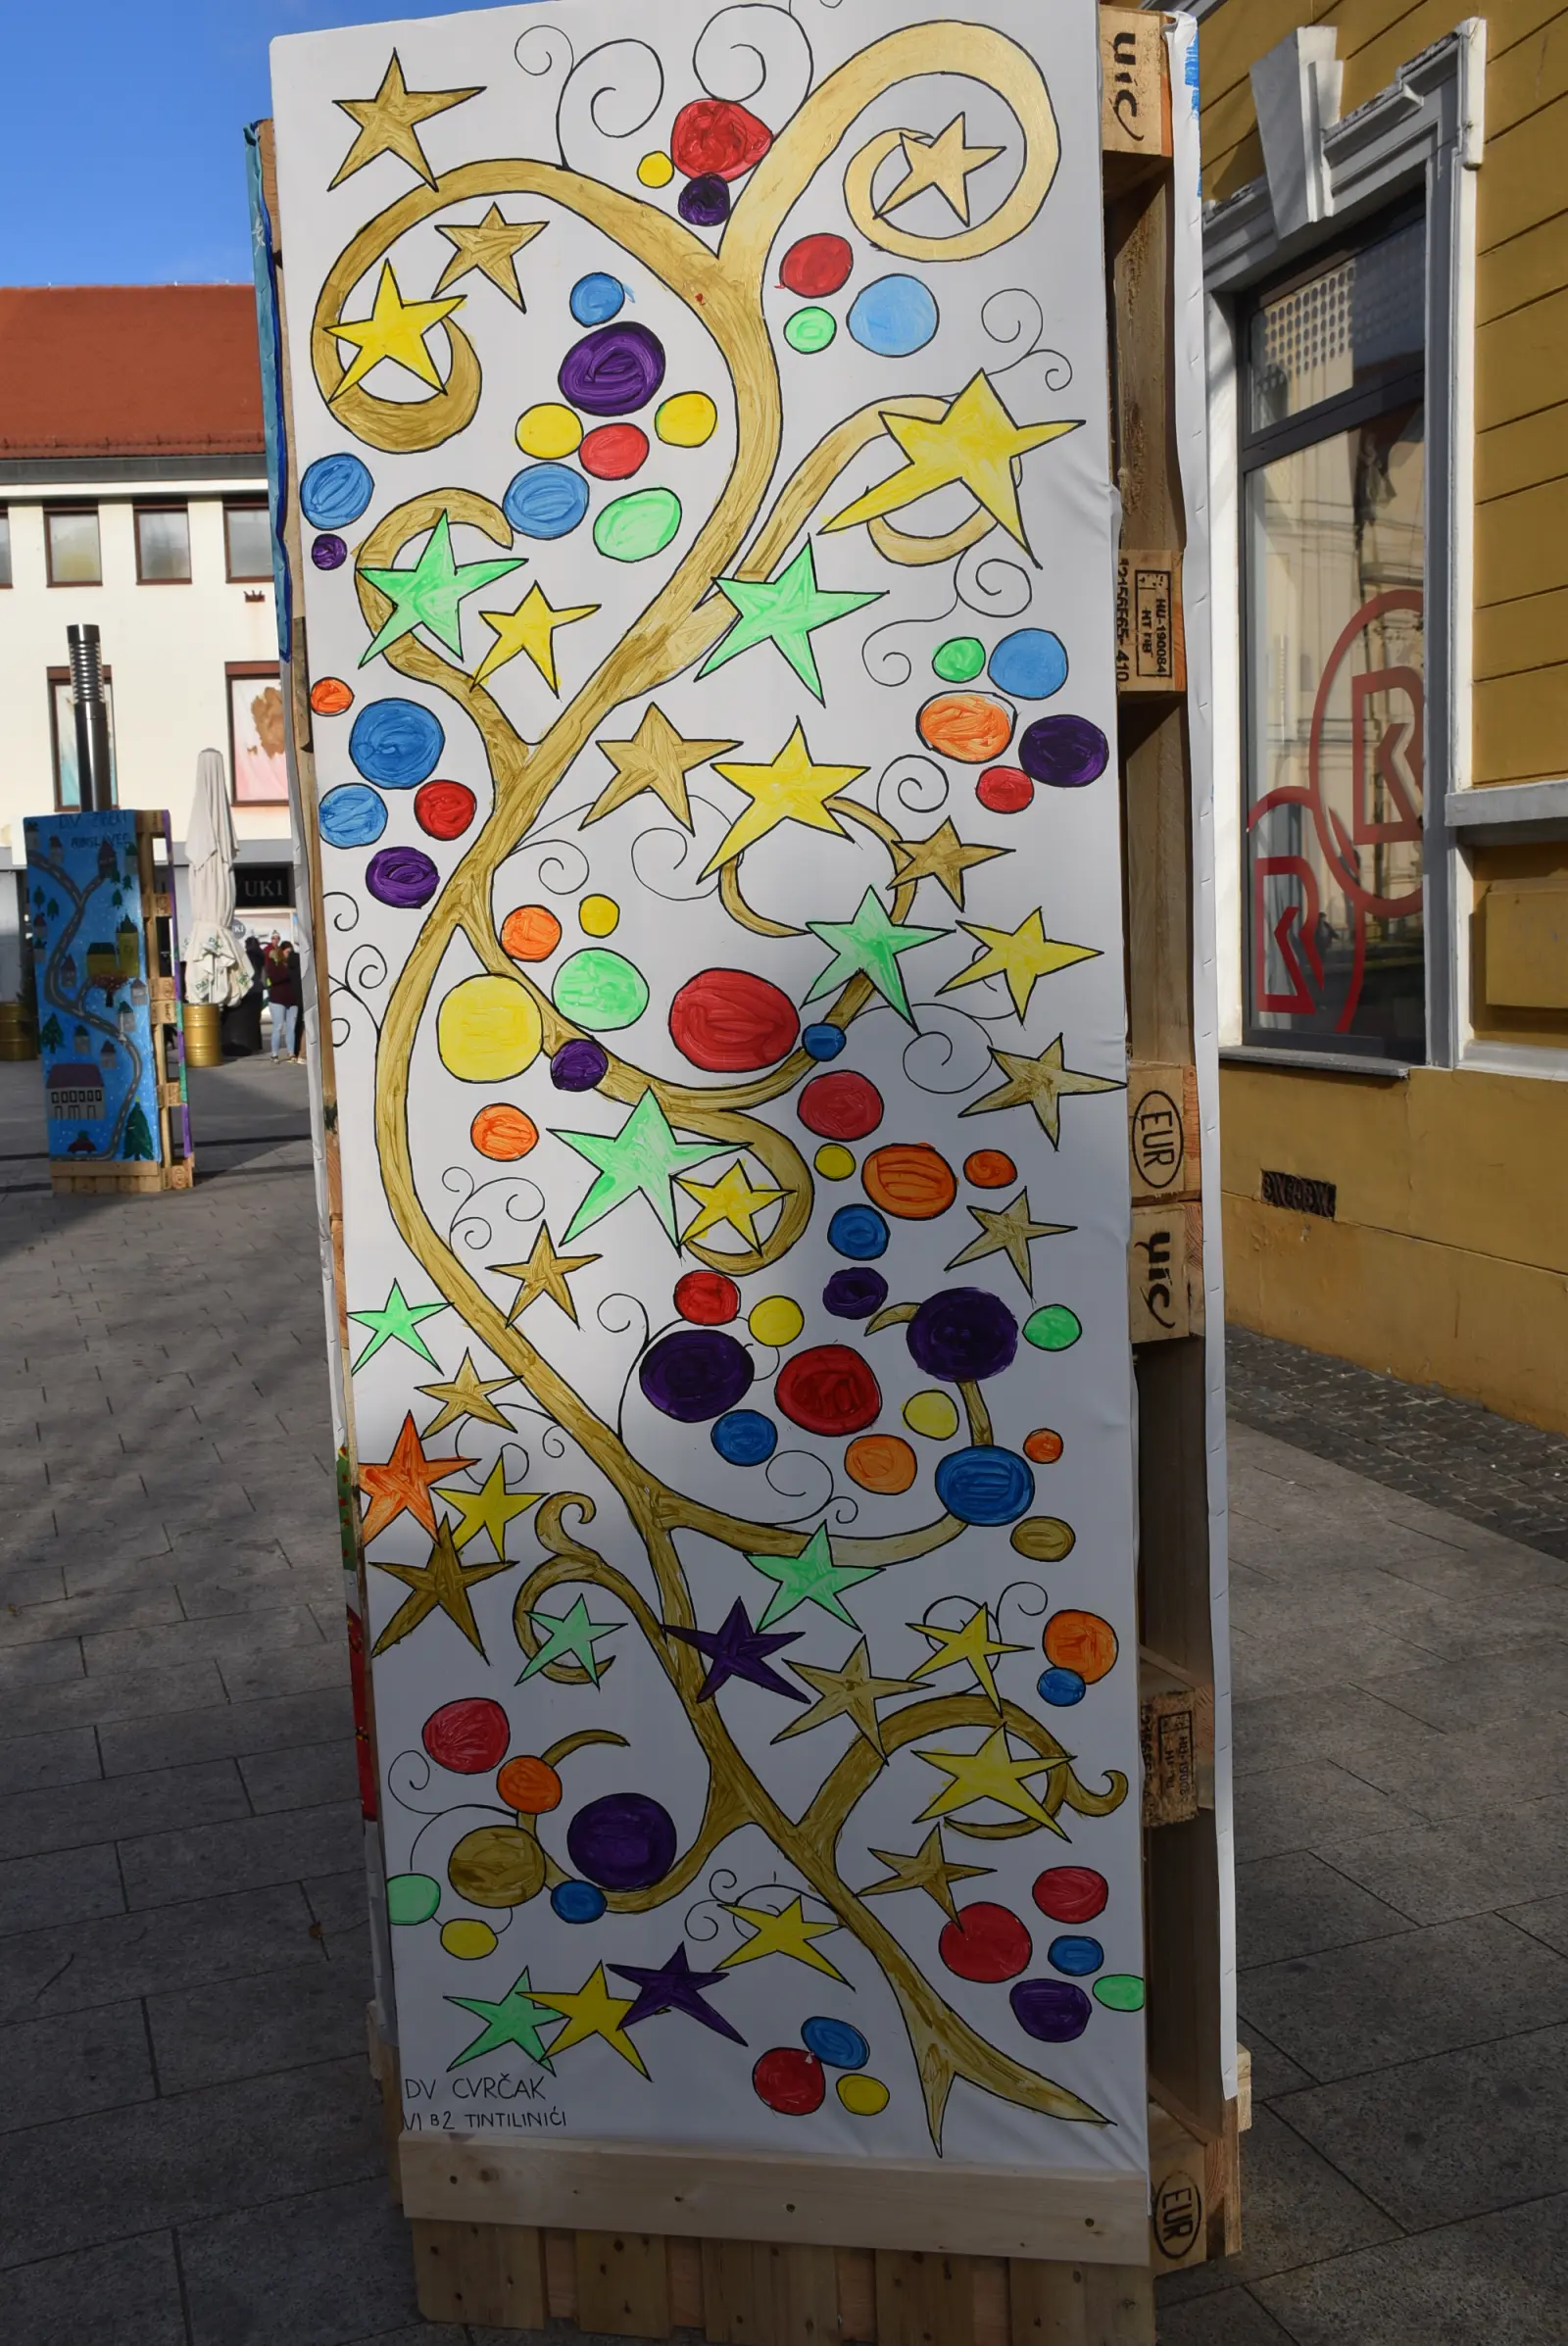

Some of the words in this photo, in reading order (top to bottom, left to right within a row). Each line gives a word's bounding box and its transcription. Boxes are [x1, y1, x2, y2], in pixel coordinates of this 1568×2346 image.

[1155, 598, 1166, 673] HU-190084
[238, 879, 284, 898] UKI
[1141, 1110, 1175, 1169] EUR
[404, 2077, 437, 2100] DV
[452, 2073, 546, 2100] CVRČAK
[430, 2110, 456, 2130] B2
[464, 2106, 567, 2128] TINTILINIĆI
[1162, 2187, 1193, 2242] EUR
